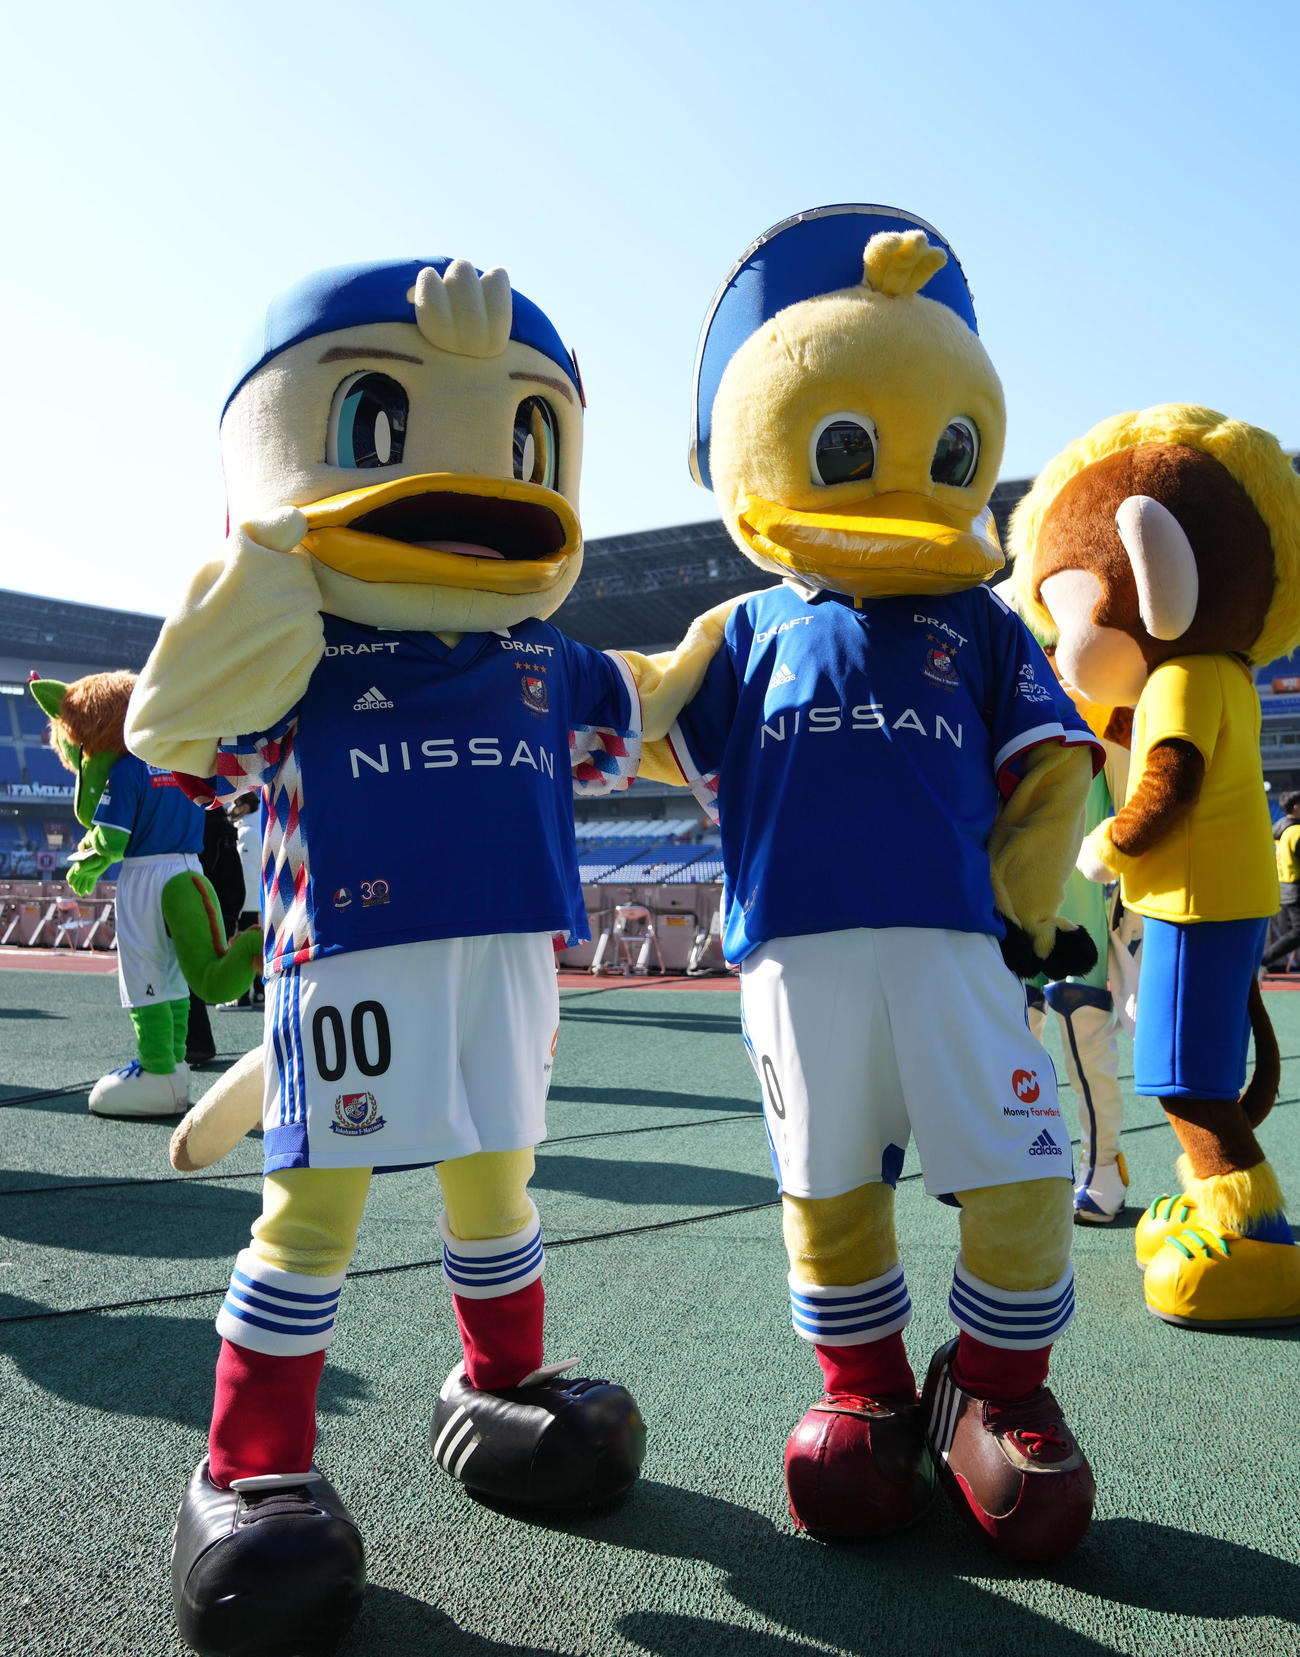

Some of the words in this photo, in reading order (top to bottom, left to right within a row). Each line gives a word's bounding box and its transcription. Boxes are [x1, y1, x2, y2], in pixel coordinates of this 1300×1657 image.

[756, 615, 815, 643] DRAFT
[913, 614, 968, 648] DRAFT
[325, 642, 400, 657] DRAFT
[501, 640, 554, 657] DRAFT
[353, 700, 394, 711] adidas
[761, 703, 963, 749] NISSAN
[349, 737, 555, 780] NISSAN
[360, 879, 390, 901] 30
[312, 1000, 391, 1082] 00
[1003, 1107, 1029, 1118] Money
[1028, 1144, 1063, 1156] adidas
